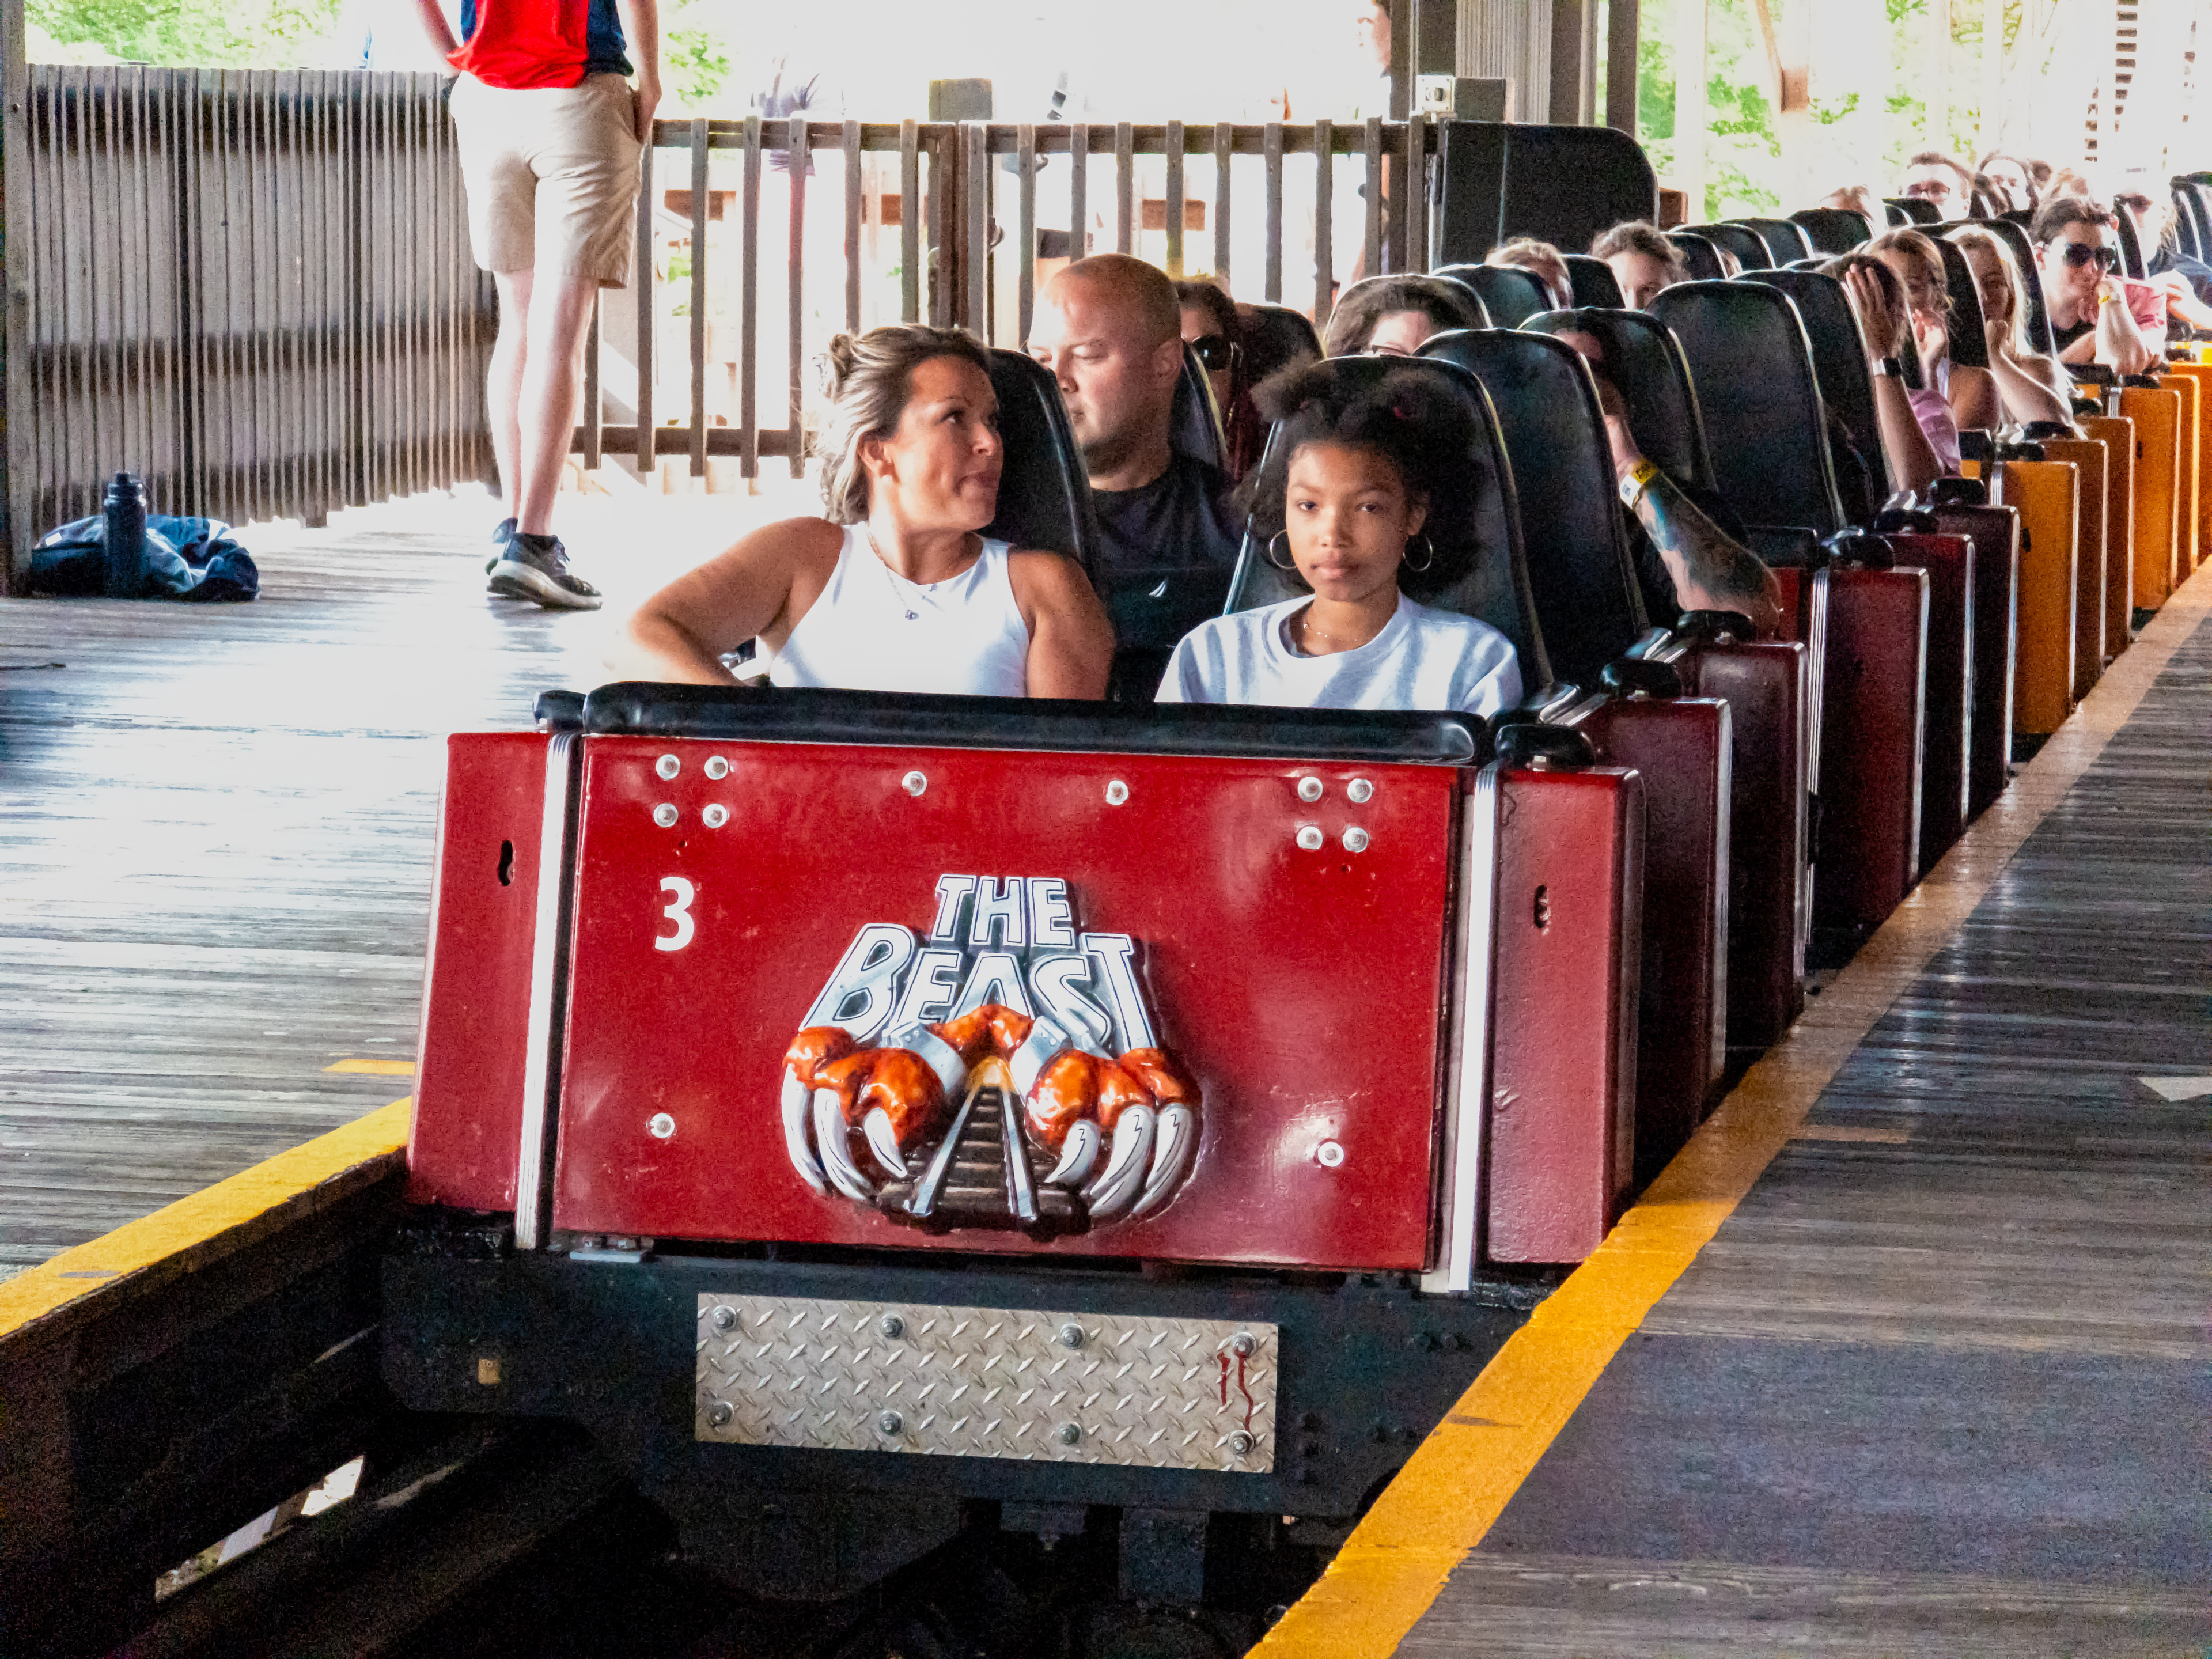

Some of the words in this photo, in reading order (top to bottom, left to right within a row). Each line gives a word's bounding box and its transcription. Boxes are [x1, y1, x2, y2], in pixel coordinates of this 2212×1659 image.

[654, 877, 694, 951] 3
[935, 873, 1075, 949] THE
[798, 923, 1157, 1051] BEAST
